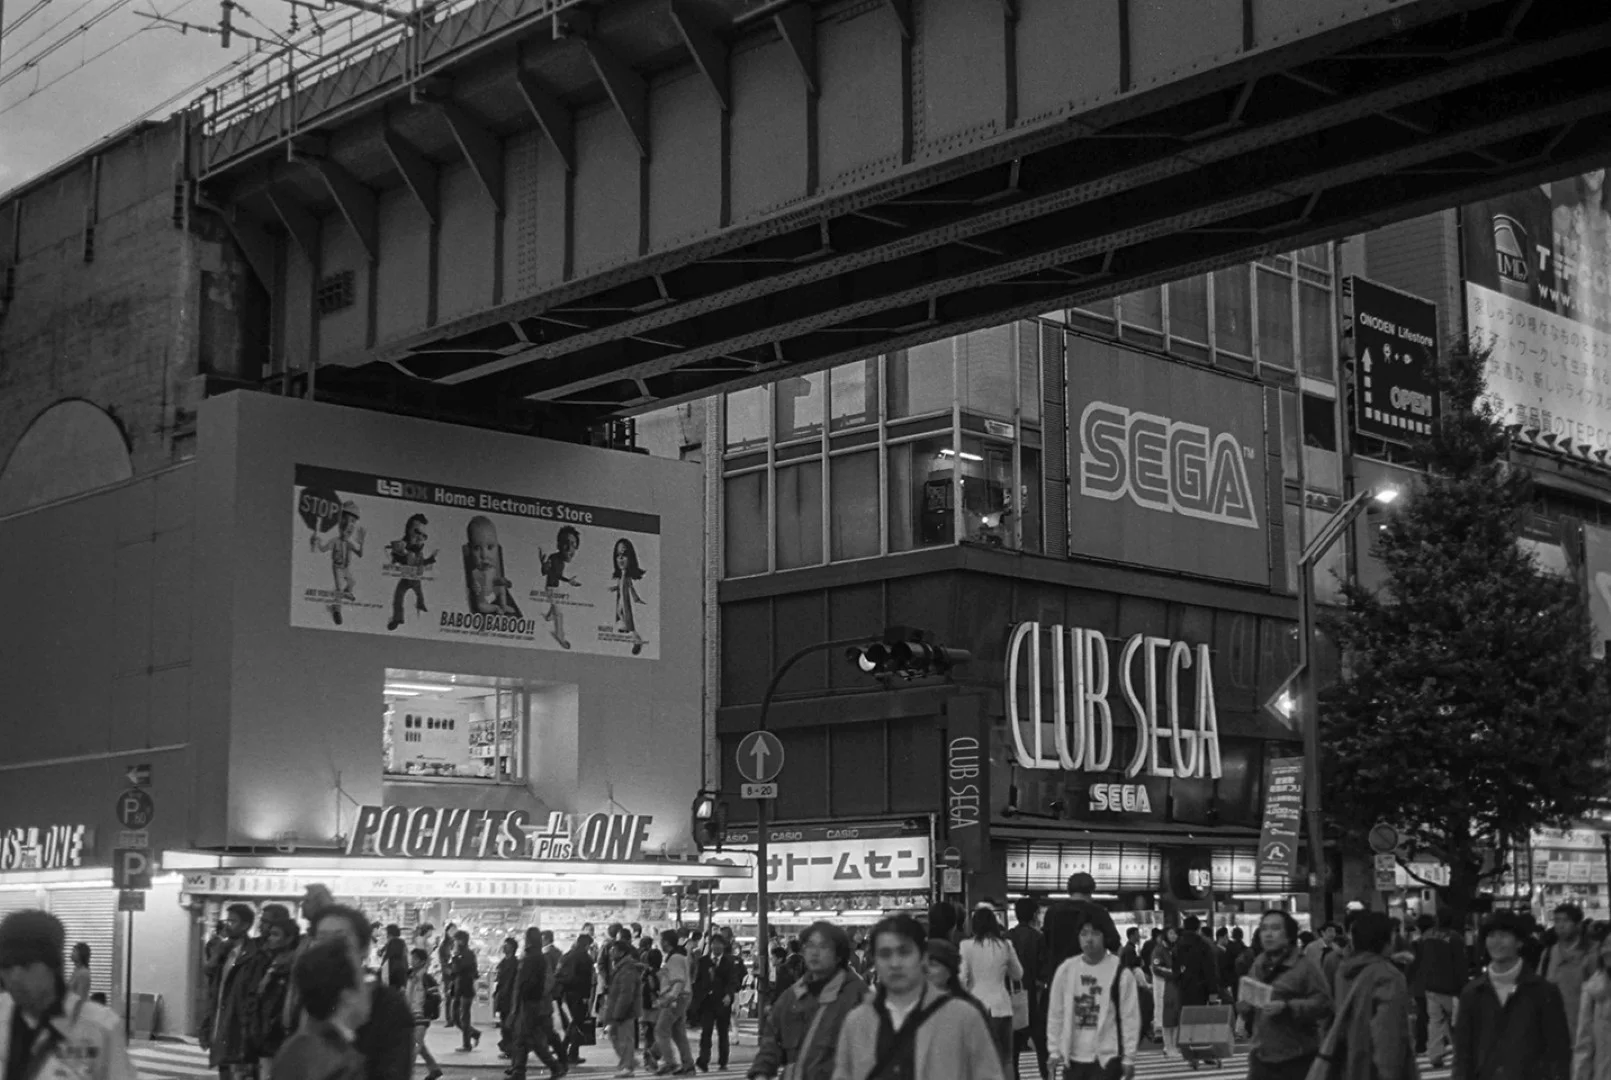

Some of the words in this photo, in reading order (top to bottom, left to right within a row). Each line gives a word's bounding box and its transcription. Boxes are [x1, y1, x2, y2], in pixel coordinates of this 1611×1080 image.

[1390, 385, 1432, 417] OPEN
[1080, 400, 1259, 529] SEGA
[300, 493, 340, 519] STOP
[435, 487, 476, 508] Home
[479, 493, 553, 520] Electronics
[556, 504, 593, 524] Store
[440, 611, 482, 630] BABOO
[486, 617, 535, 635] BABOO!!
[1006, 621, 1113, 772] CLUB
[1119, 633, 1222, 778] SEGA
[949, 737, 980, 780] CLUB
[124, 799, 139, 823] P
[949, 784, 980, 829] SEGA
[1089, 783, 1152, 812] SEGA
[345, 805, 530, 858] POCKETS
[578, 812, 653, 860] ONE
[770, 831, 803, 842] CASIO
[826, 829, 859, 840] CASIO
[124, 853, 147, 885] P
